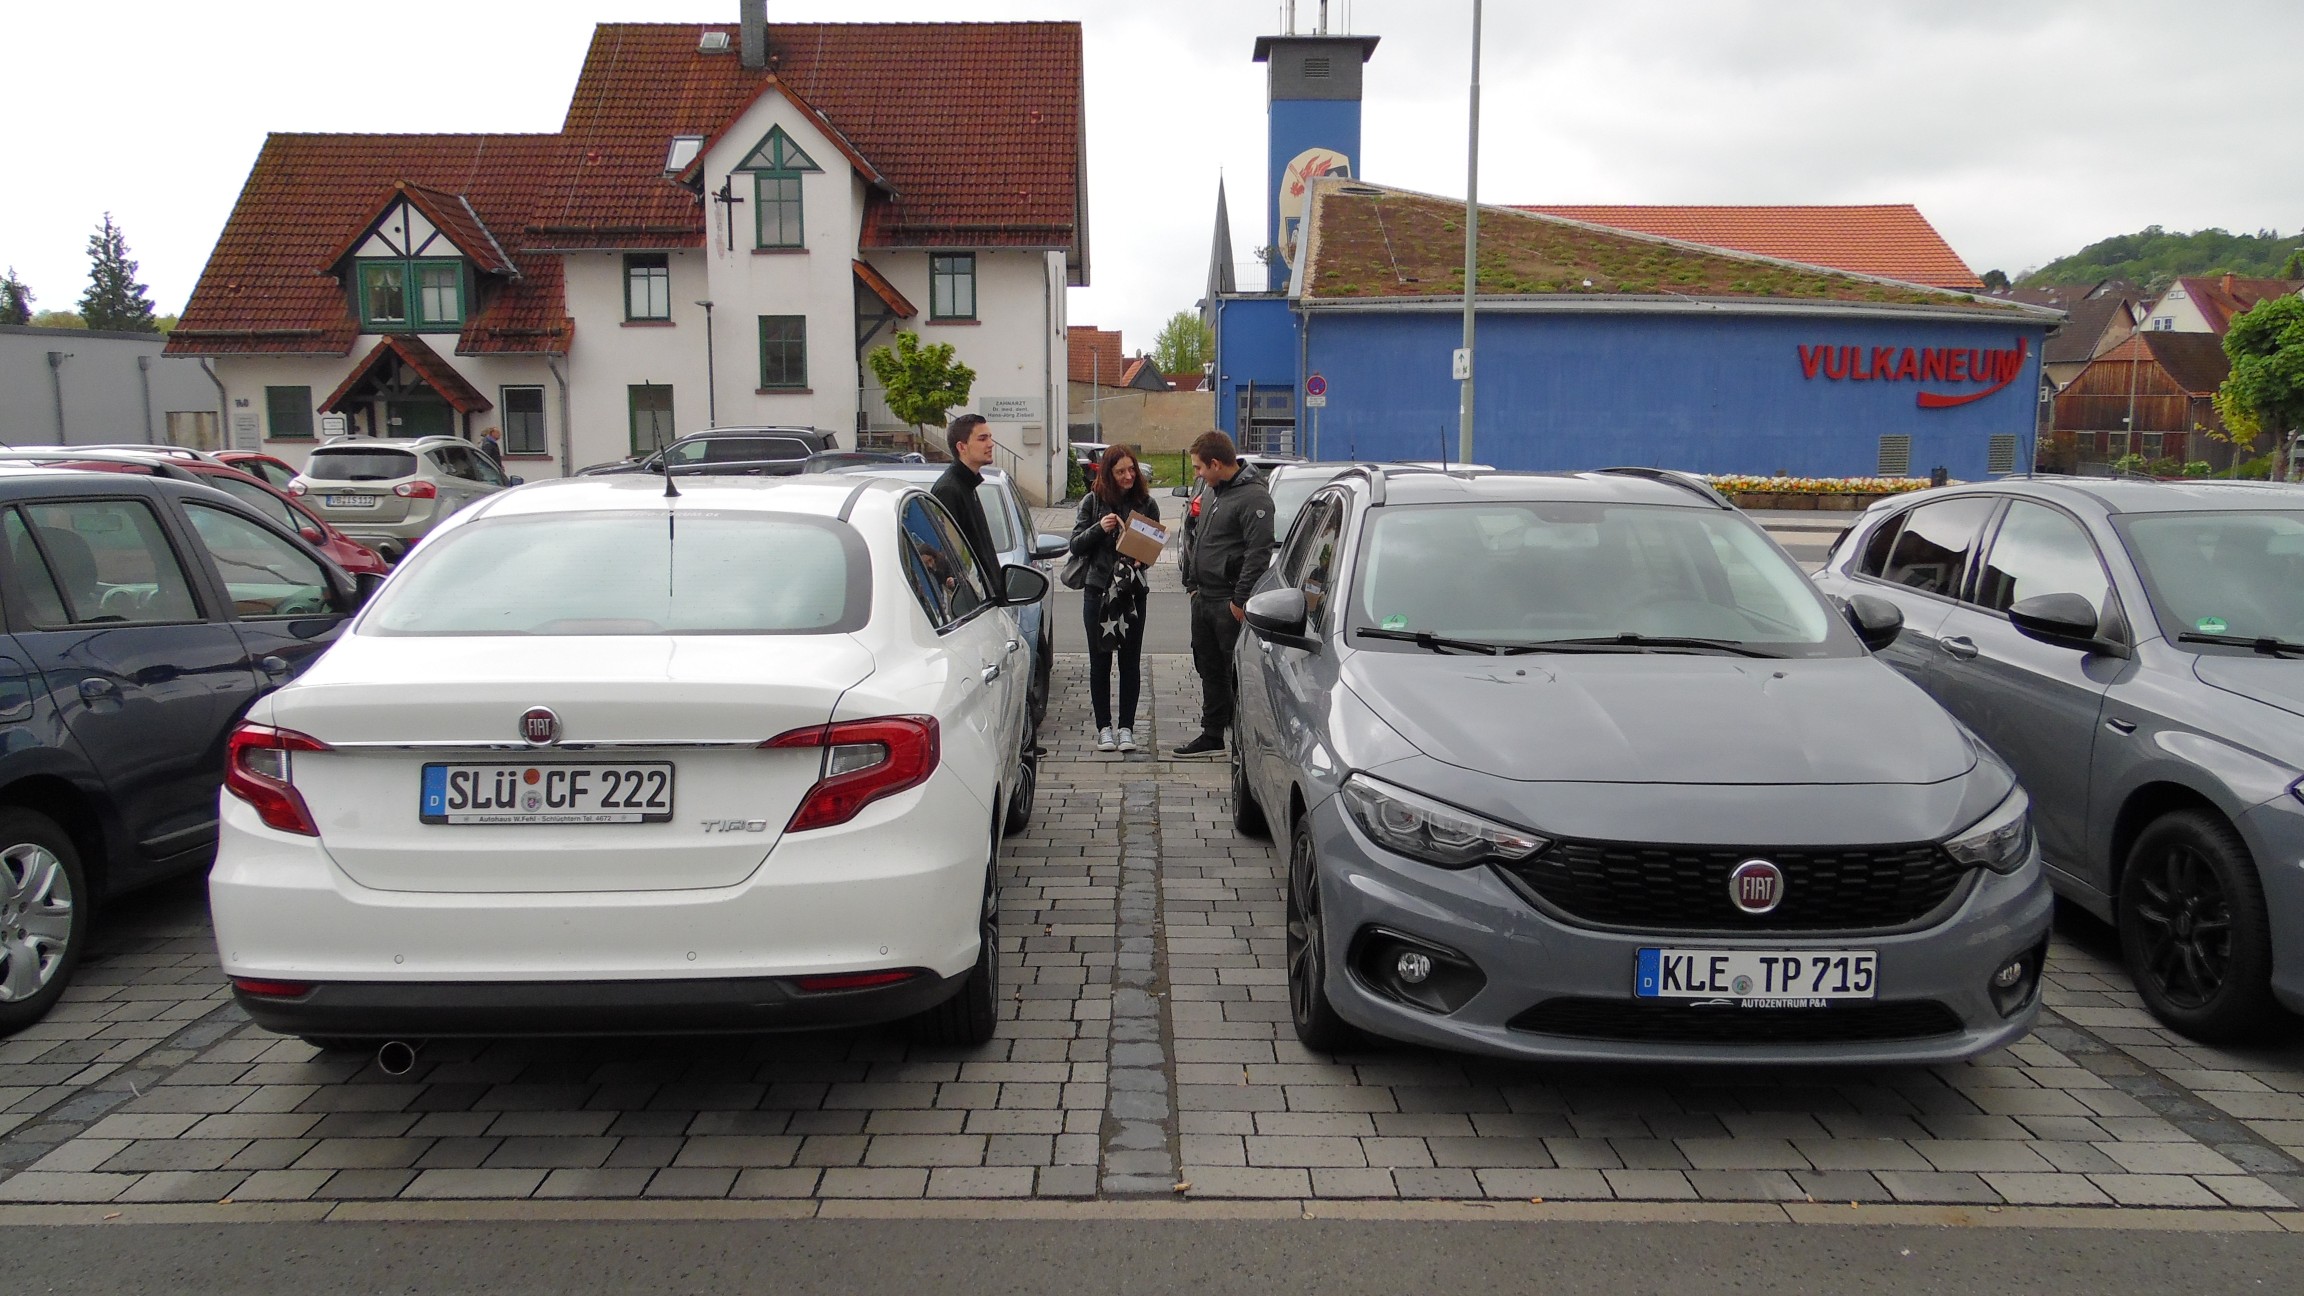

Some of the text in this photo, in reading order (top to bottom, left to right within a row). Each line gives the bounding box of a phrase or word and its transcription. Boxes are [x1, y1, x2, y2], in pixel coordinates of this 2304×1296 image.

[1798, 344, 2021, 382] VULKANEUM
[527, 718, 551, 736] FIAT
[430, 795, 439, 806] D
[545, 770, 591, 809] CF
[600, 770, 667, 808] 222
[479, 815, 512, 823] Autohaus
[701, 819, 767, 833] TIPO
[1742, 876, 1774, 900] FIAT
[1644, 955, 1873, 992] D KLE TP 715
[1741, 998, 1827, 1008] AUTOZENTRUM P&A
